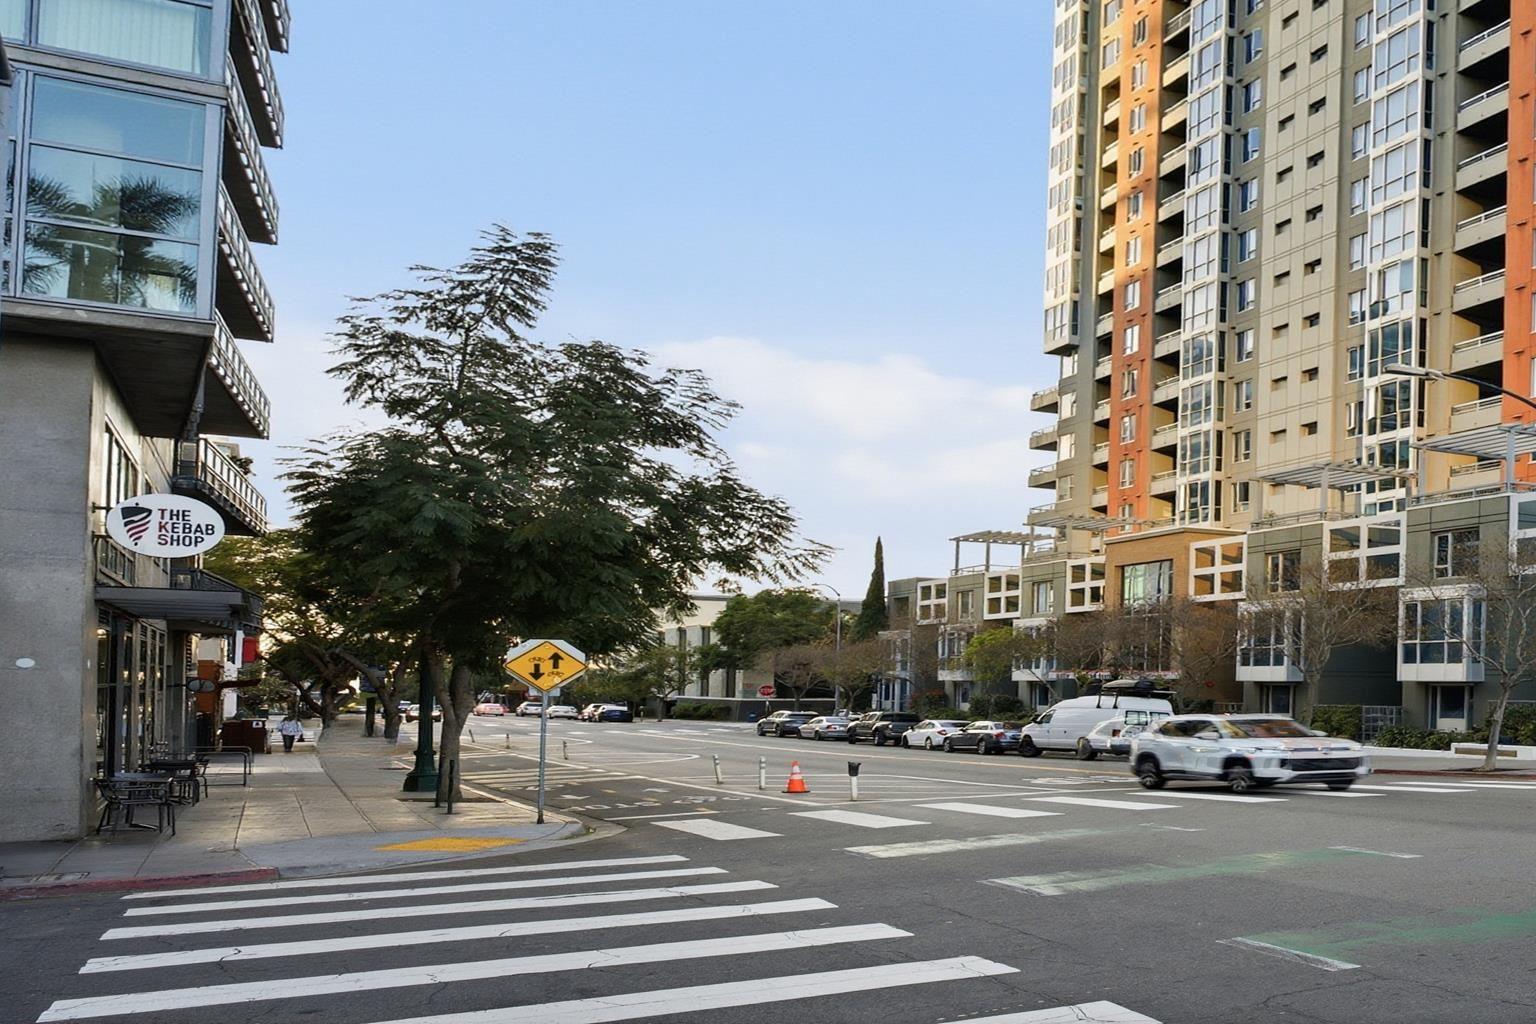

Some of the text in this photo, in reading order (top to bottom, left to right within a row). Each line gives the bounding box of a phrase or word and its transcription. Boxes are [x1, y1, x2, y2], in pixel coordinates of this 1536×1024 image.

[157, 508, 191, 522] THE
[158, 521, 215, 536] KEBAB
[157, 534, 205, 547] SHOP
